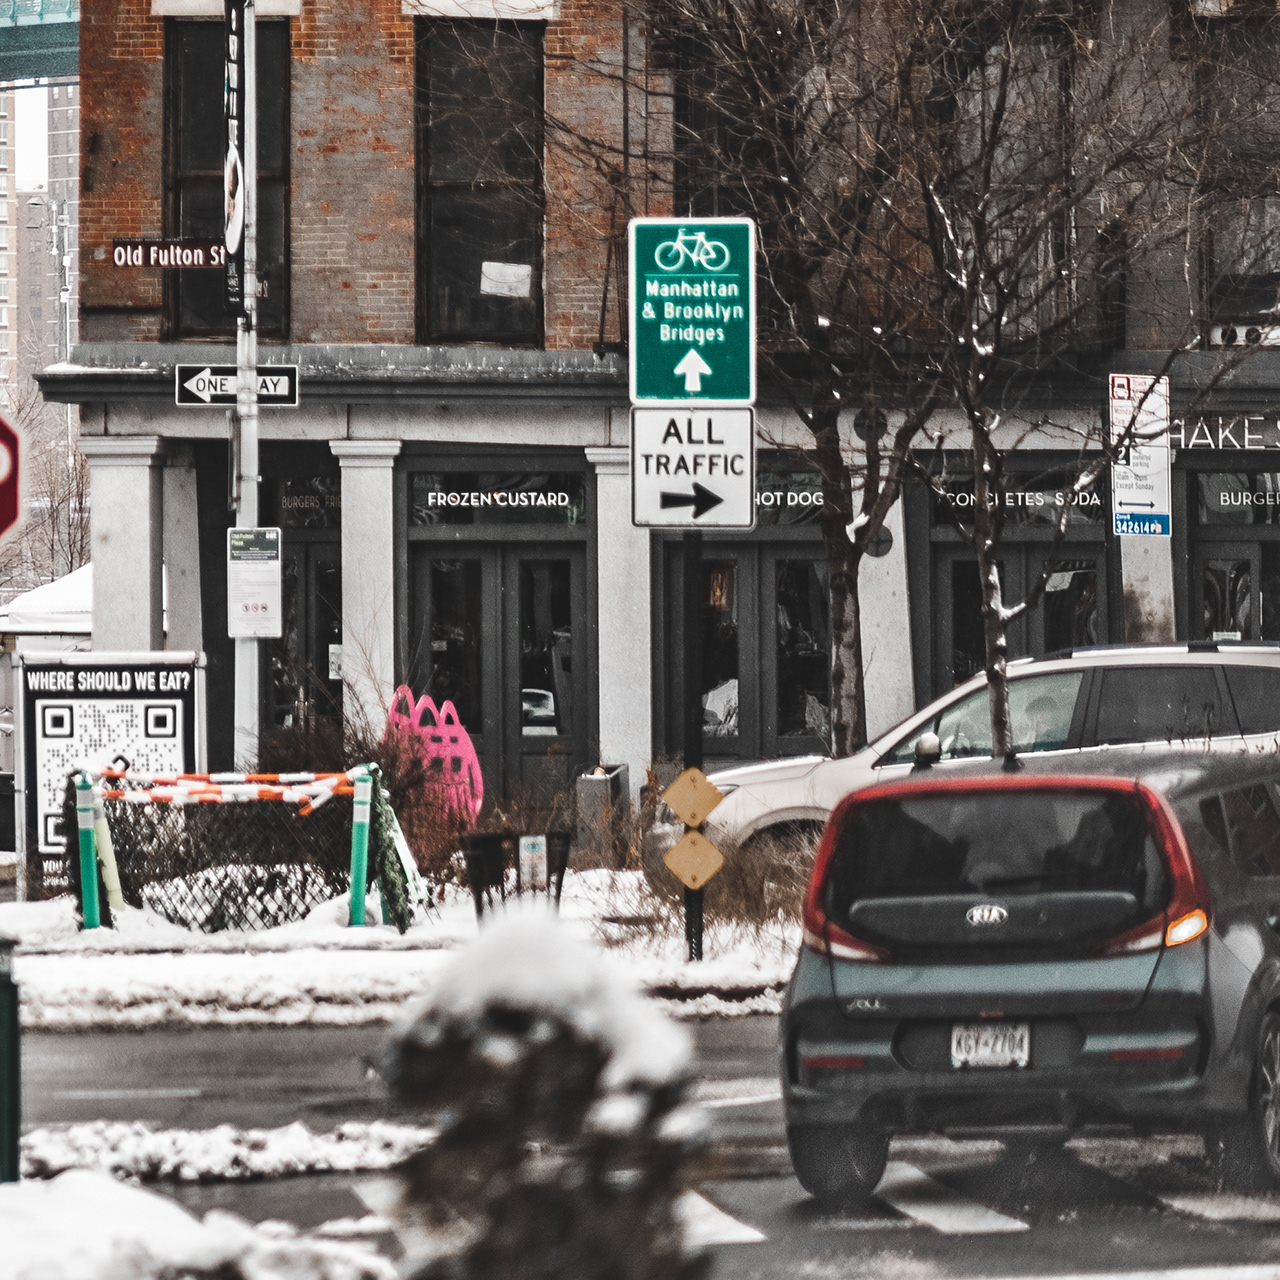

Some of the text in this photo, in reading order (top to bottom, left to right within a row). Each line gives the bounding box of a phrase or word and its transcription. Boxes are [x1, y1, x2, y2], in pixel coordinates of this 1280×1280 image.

[114, 245, 226, 266] Old Fulton St
[646, 280, 739, 297] Manhattan
[642, 301, 744, 323] & Brooklyn
[660, 323, 725, 345] Bridges
[196, 378, 281, 393] ONE AY
[662, 418, 724, 444] ALL
[1170, 417, 1266, 449] HAKE
[641, 454, 744, 475] TRAFFIC
[1116, 481, 1154, 492] Except Sunday
[282, 495, 342, 508] BURGERS FRIE
[428, 492, 569, 507] FROZEN CUSTARD
[1116, 521, 1149, 533] 342614
[27, 671, 190, 691] WHERE SHOULD WE EAT?
[971, 907, 1003, 923] KIA
